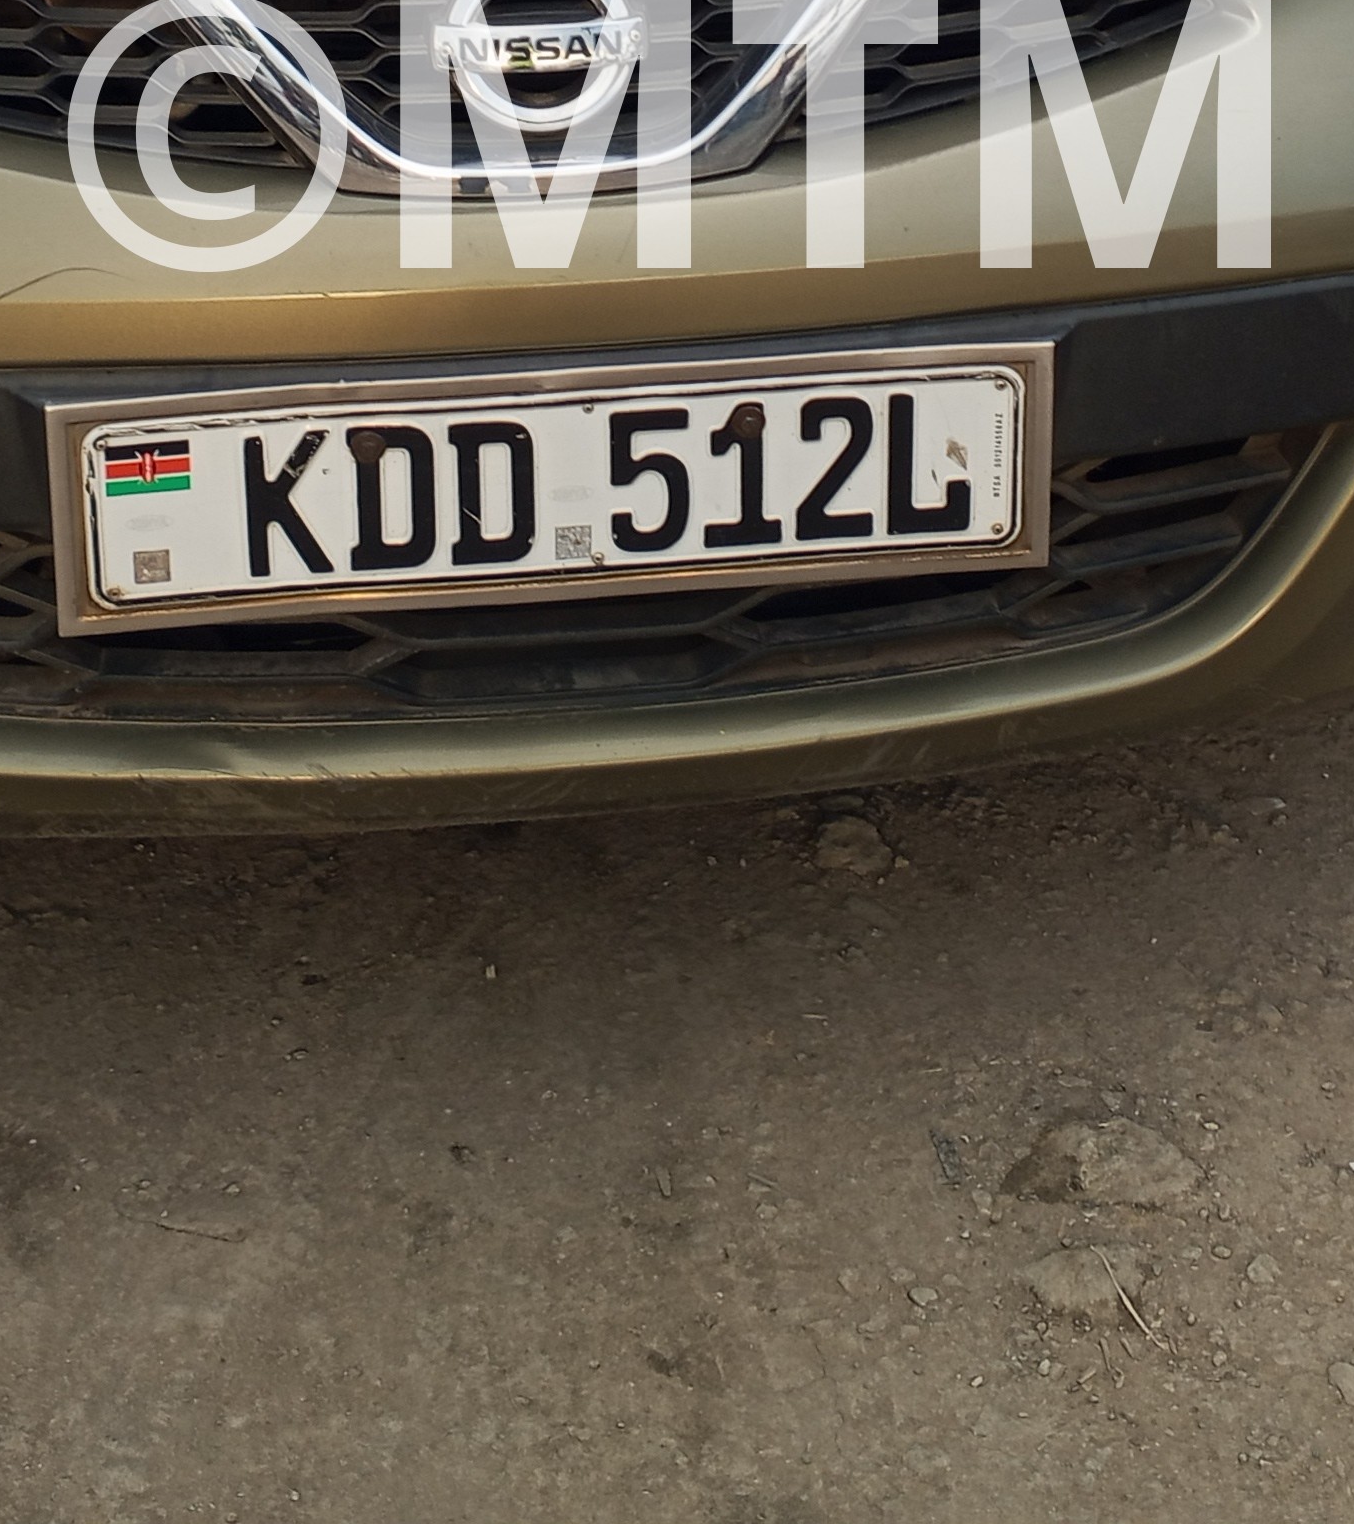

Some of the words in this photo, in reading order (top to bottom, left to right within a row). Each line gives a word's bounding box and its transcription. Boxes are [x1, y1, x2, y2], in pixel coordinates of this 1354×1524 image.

[458, 29, 622, 62] NISSAN
[244, 422, 535, 577] KDD
[610, 393, 973, 552] 512L
